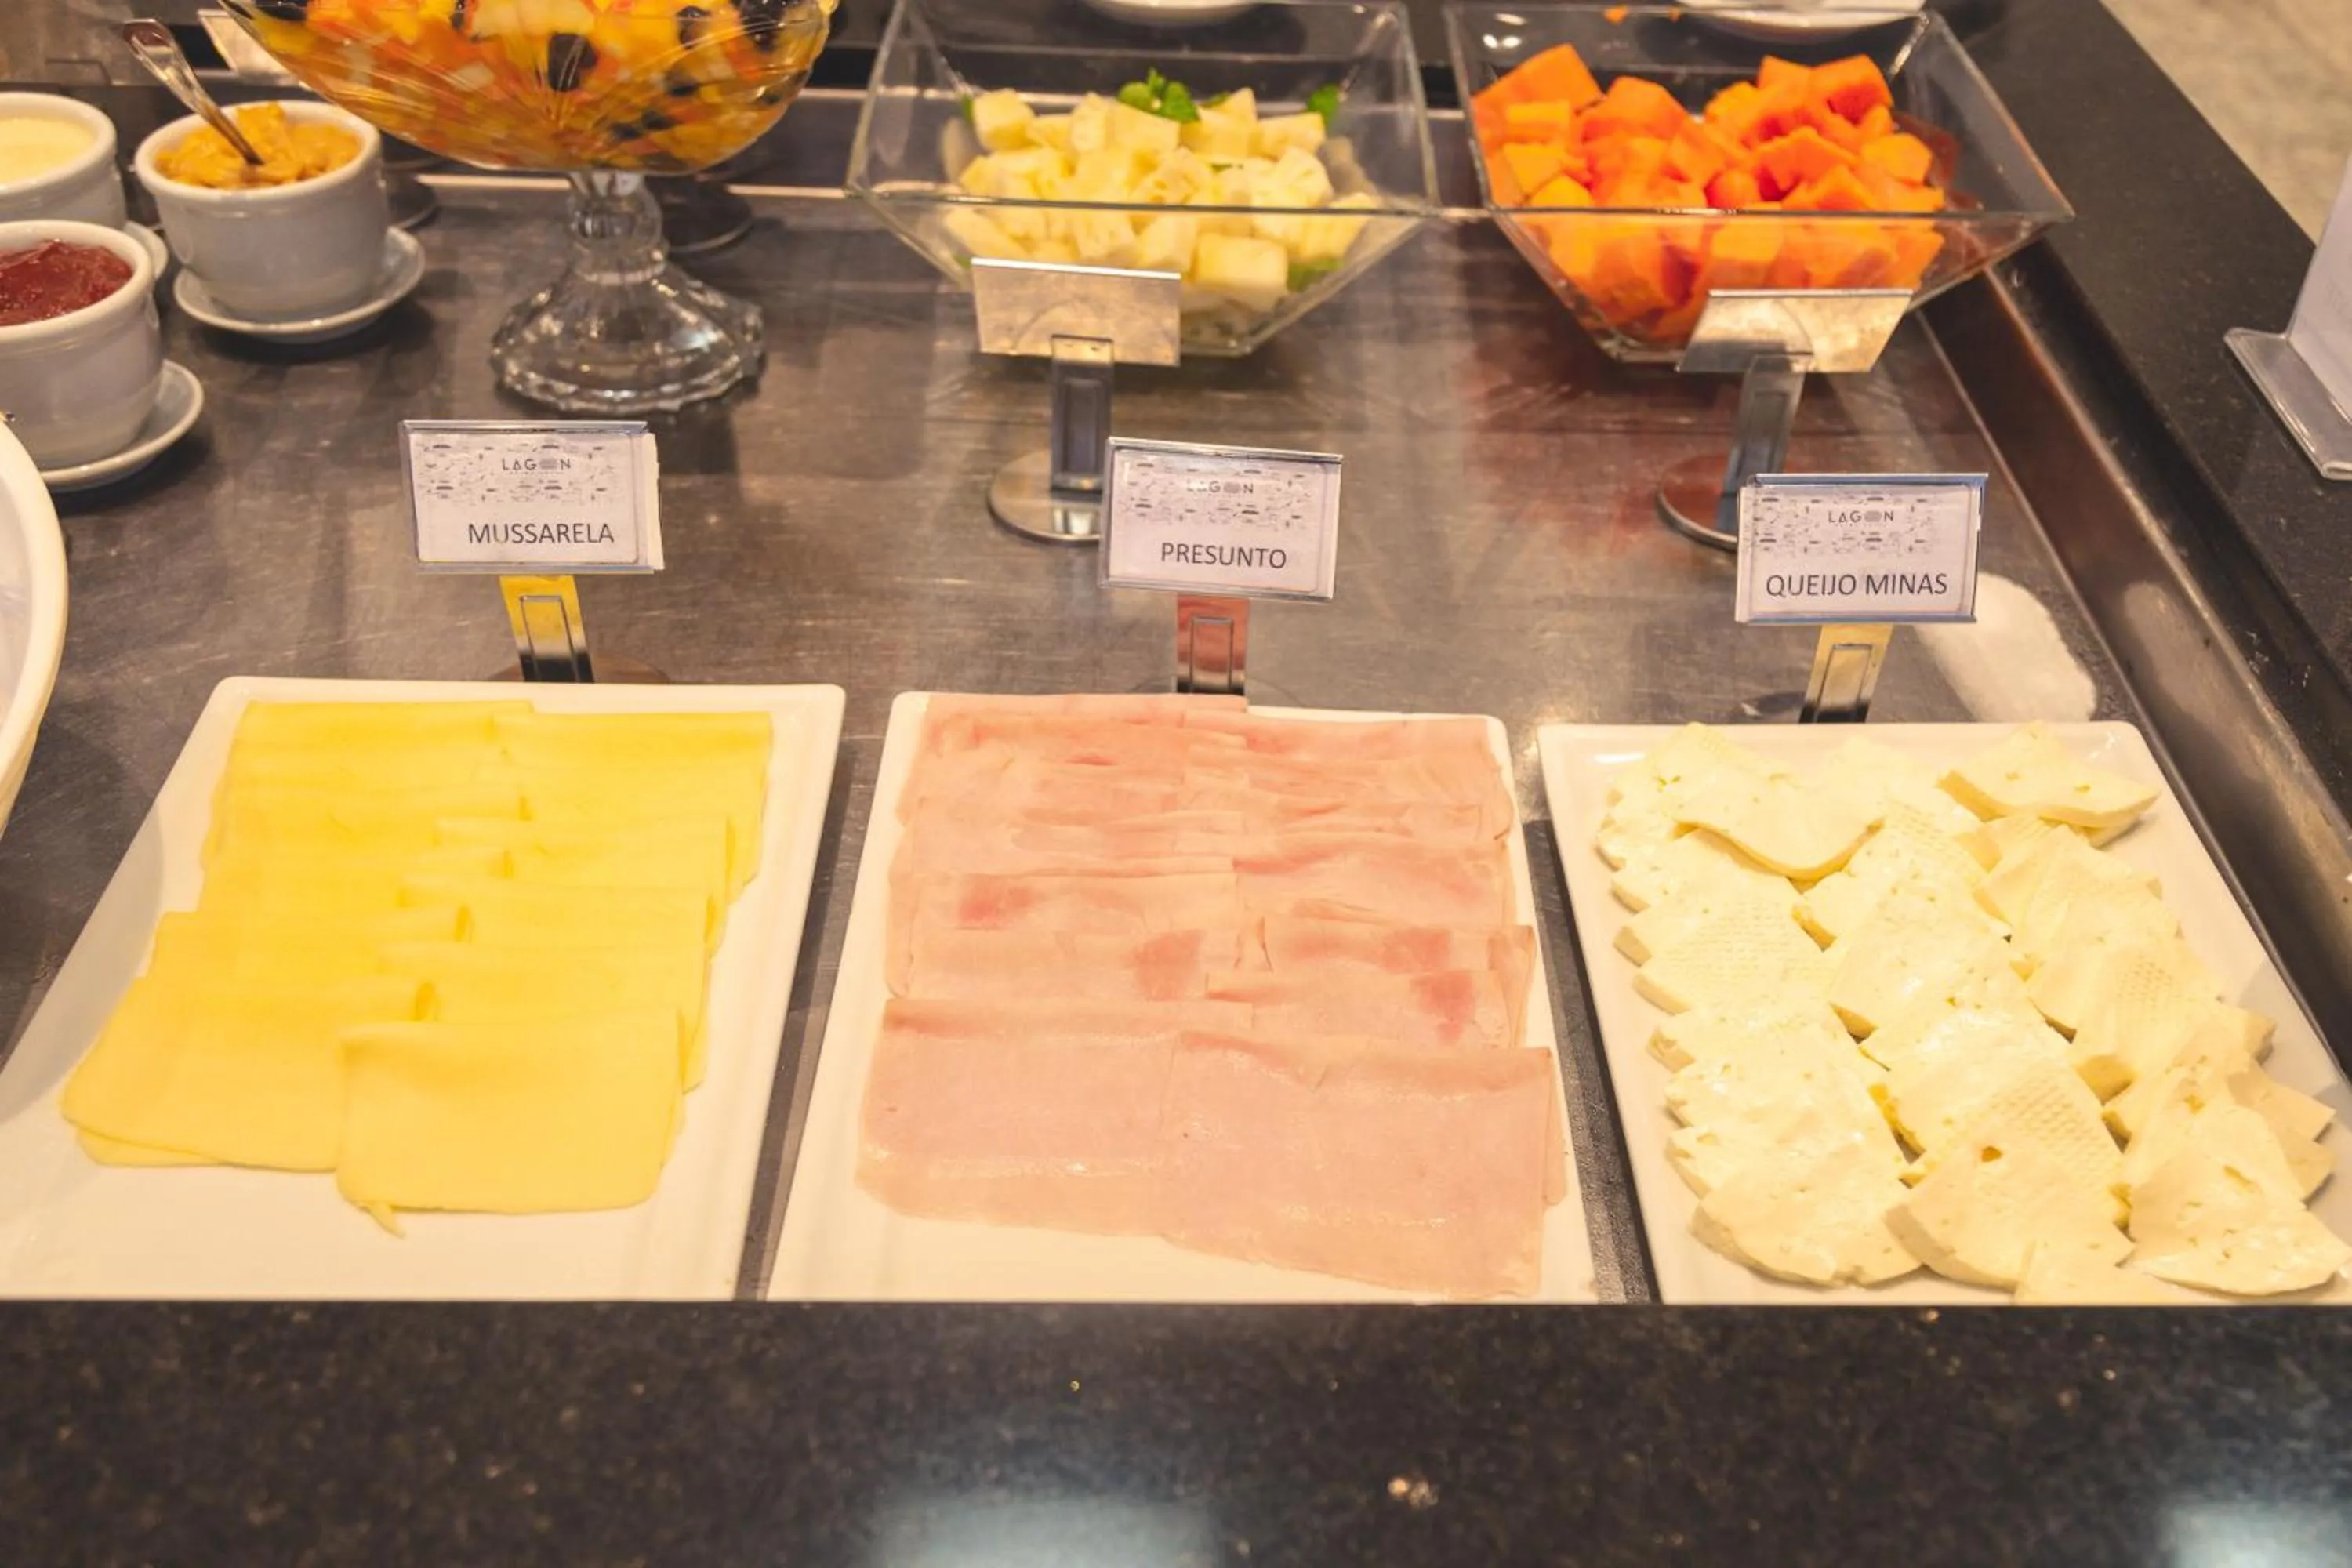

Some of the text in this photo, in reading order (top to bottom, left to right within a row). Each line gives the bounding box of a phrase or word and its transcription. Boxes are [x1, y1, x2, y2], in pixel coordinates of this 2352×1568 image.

[469, 523, 614, 543] MUSSARELA
[1161, 542, 1287, 569] PRESUNTO
[1766, 573, 1947, 598] QUEIJO MINAS
